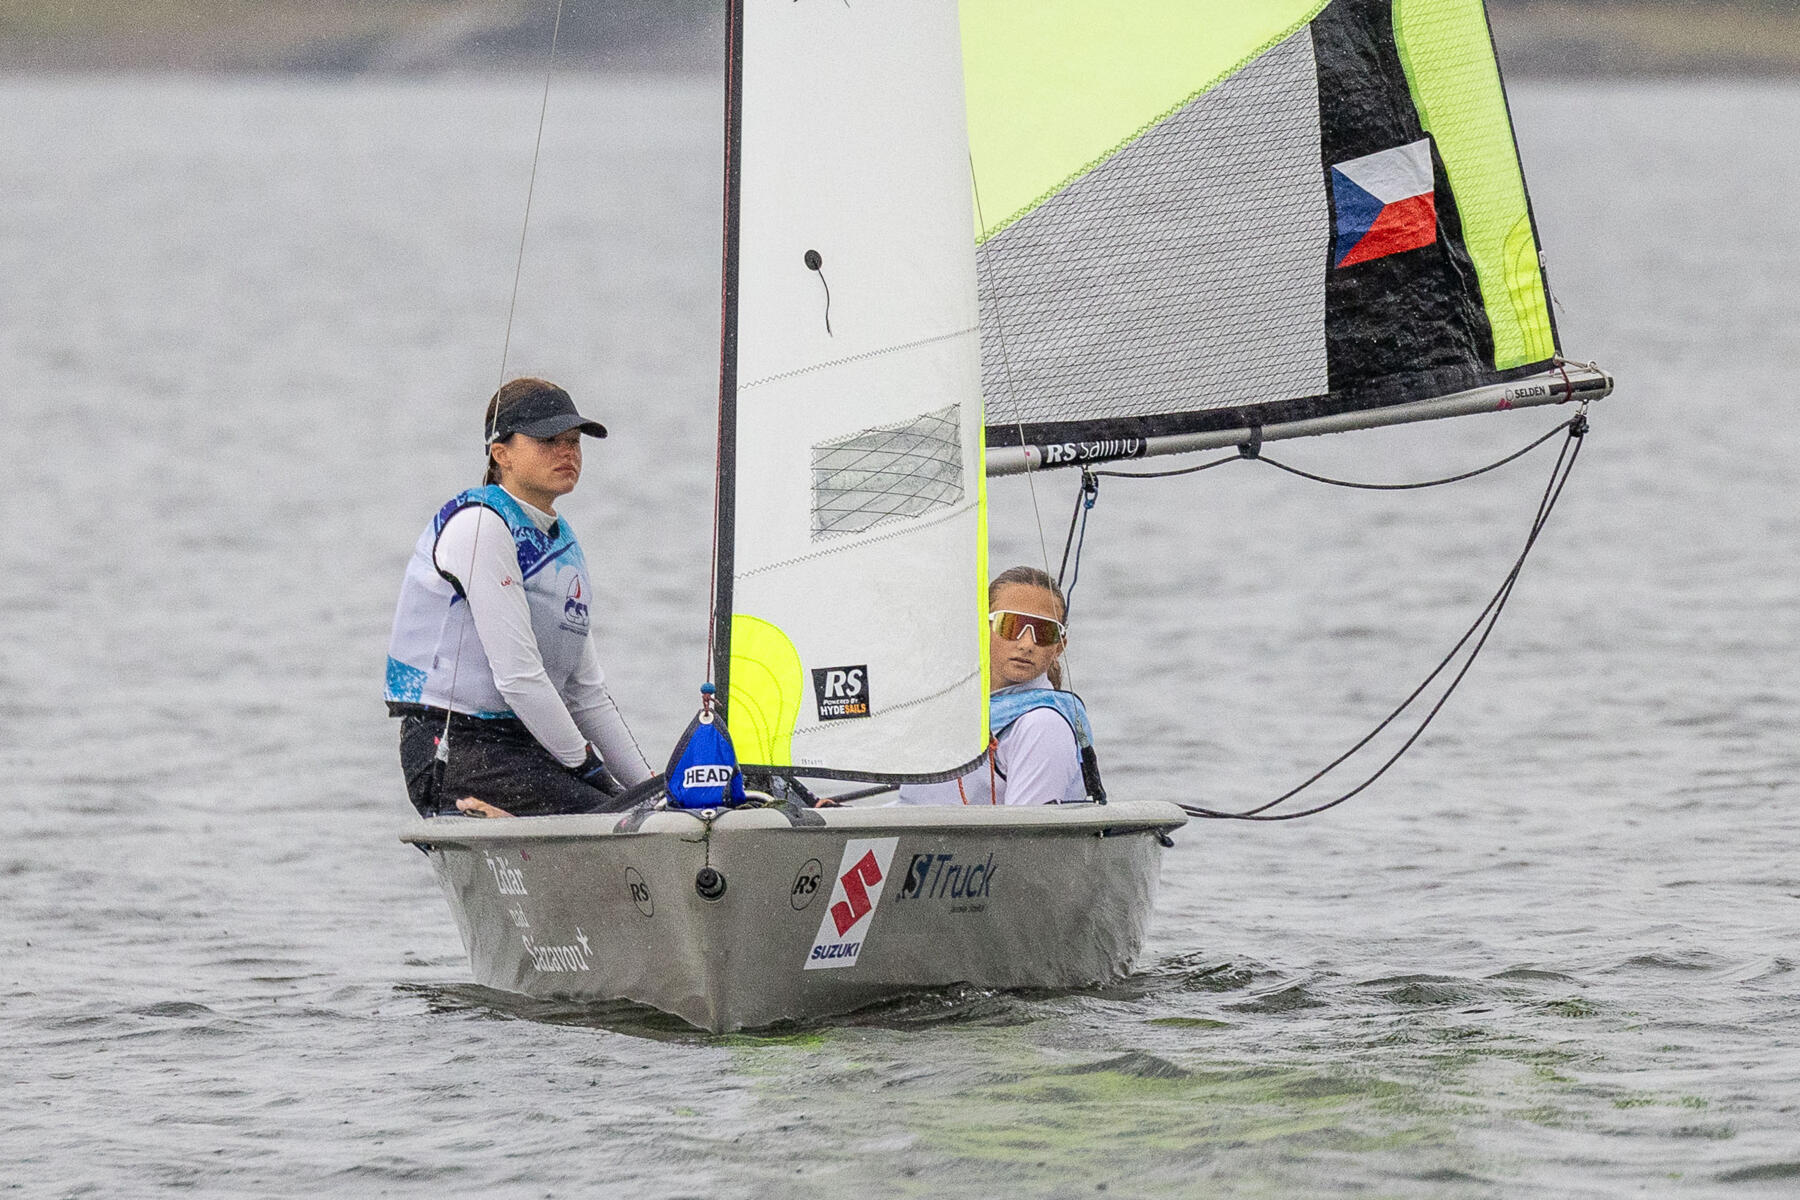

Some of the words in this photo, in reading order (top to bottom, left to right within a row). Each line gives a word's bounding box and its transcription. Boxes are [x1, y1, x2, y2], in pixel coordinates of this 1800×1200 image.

[1046, 442, 1077, 463] RS
[824, 668, 863, 698] RS
[686, 768, 731, 785] HEAD
[630, 883, 649, 902] RS
[793, 874, 820, 895] RS
[811, 942, 861, 960] SUZUKI
